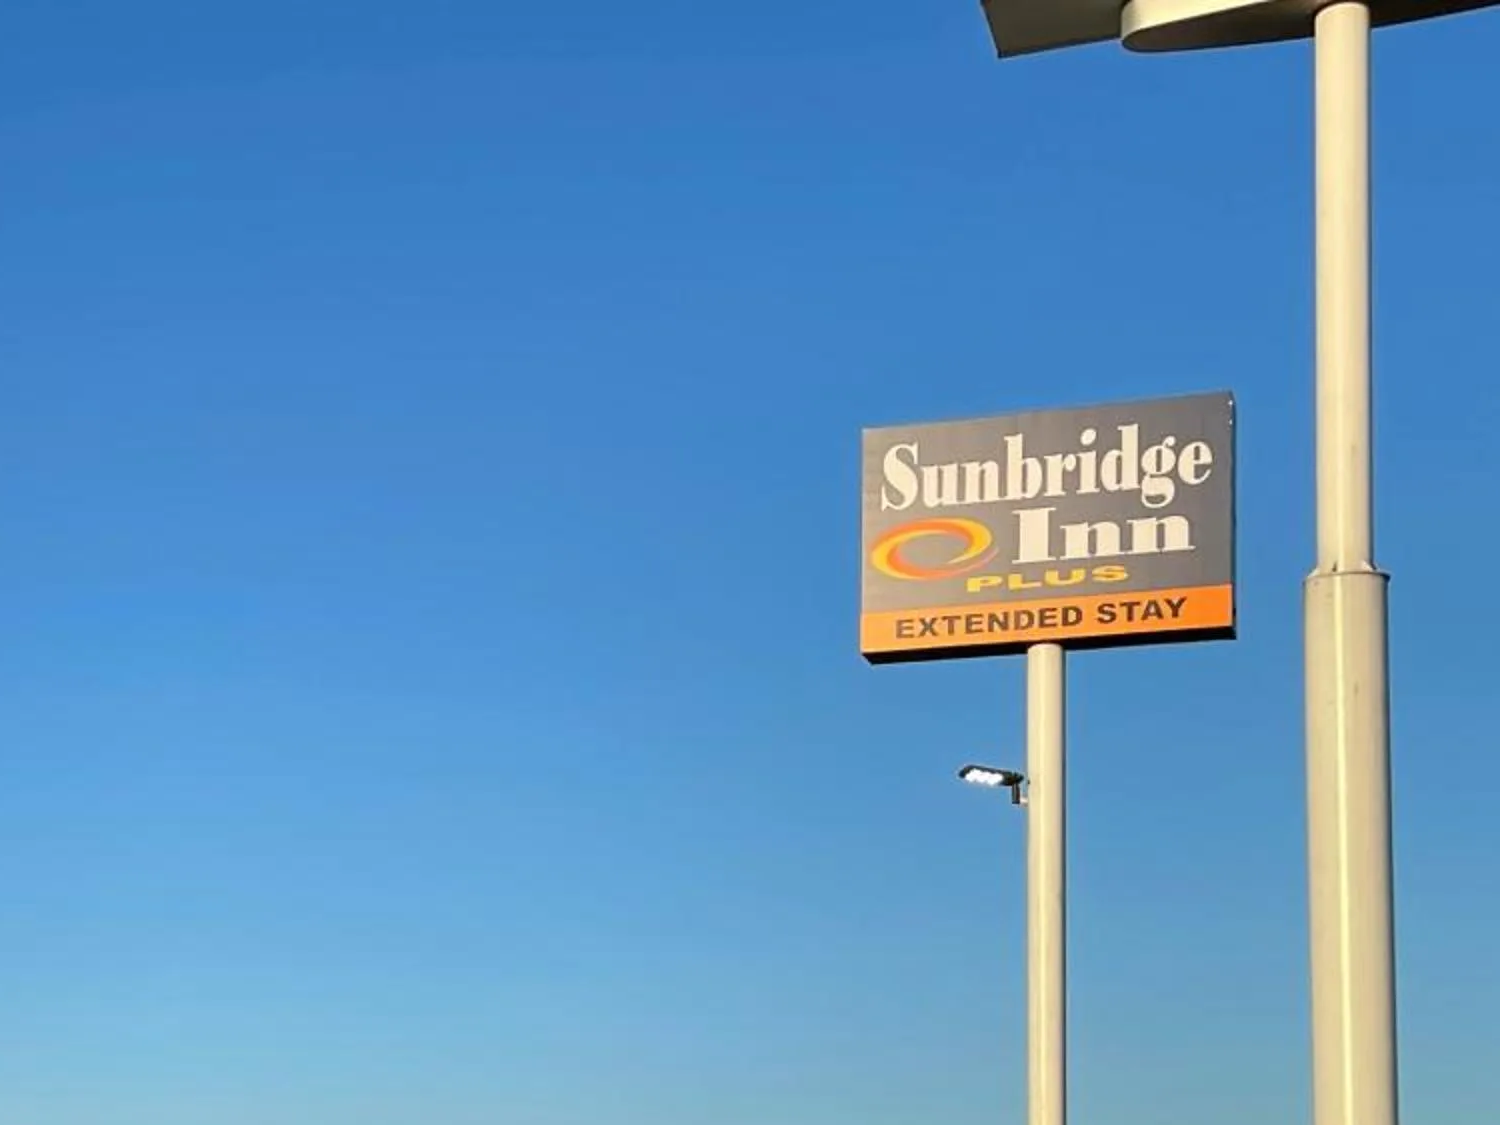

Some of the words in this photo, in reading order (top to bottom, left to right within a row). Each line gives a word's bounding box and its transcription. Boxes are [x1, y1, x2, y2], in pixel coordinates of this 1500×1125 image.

[881, 423, 1213, 511] Sunbridge
[1012, 507, 1195, 564] Inn
[966, 565, 1129, 593] PLUS
[895, 606, 1083, 638] EXTENDED
[1097, 597, 1187, 624] STAY
